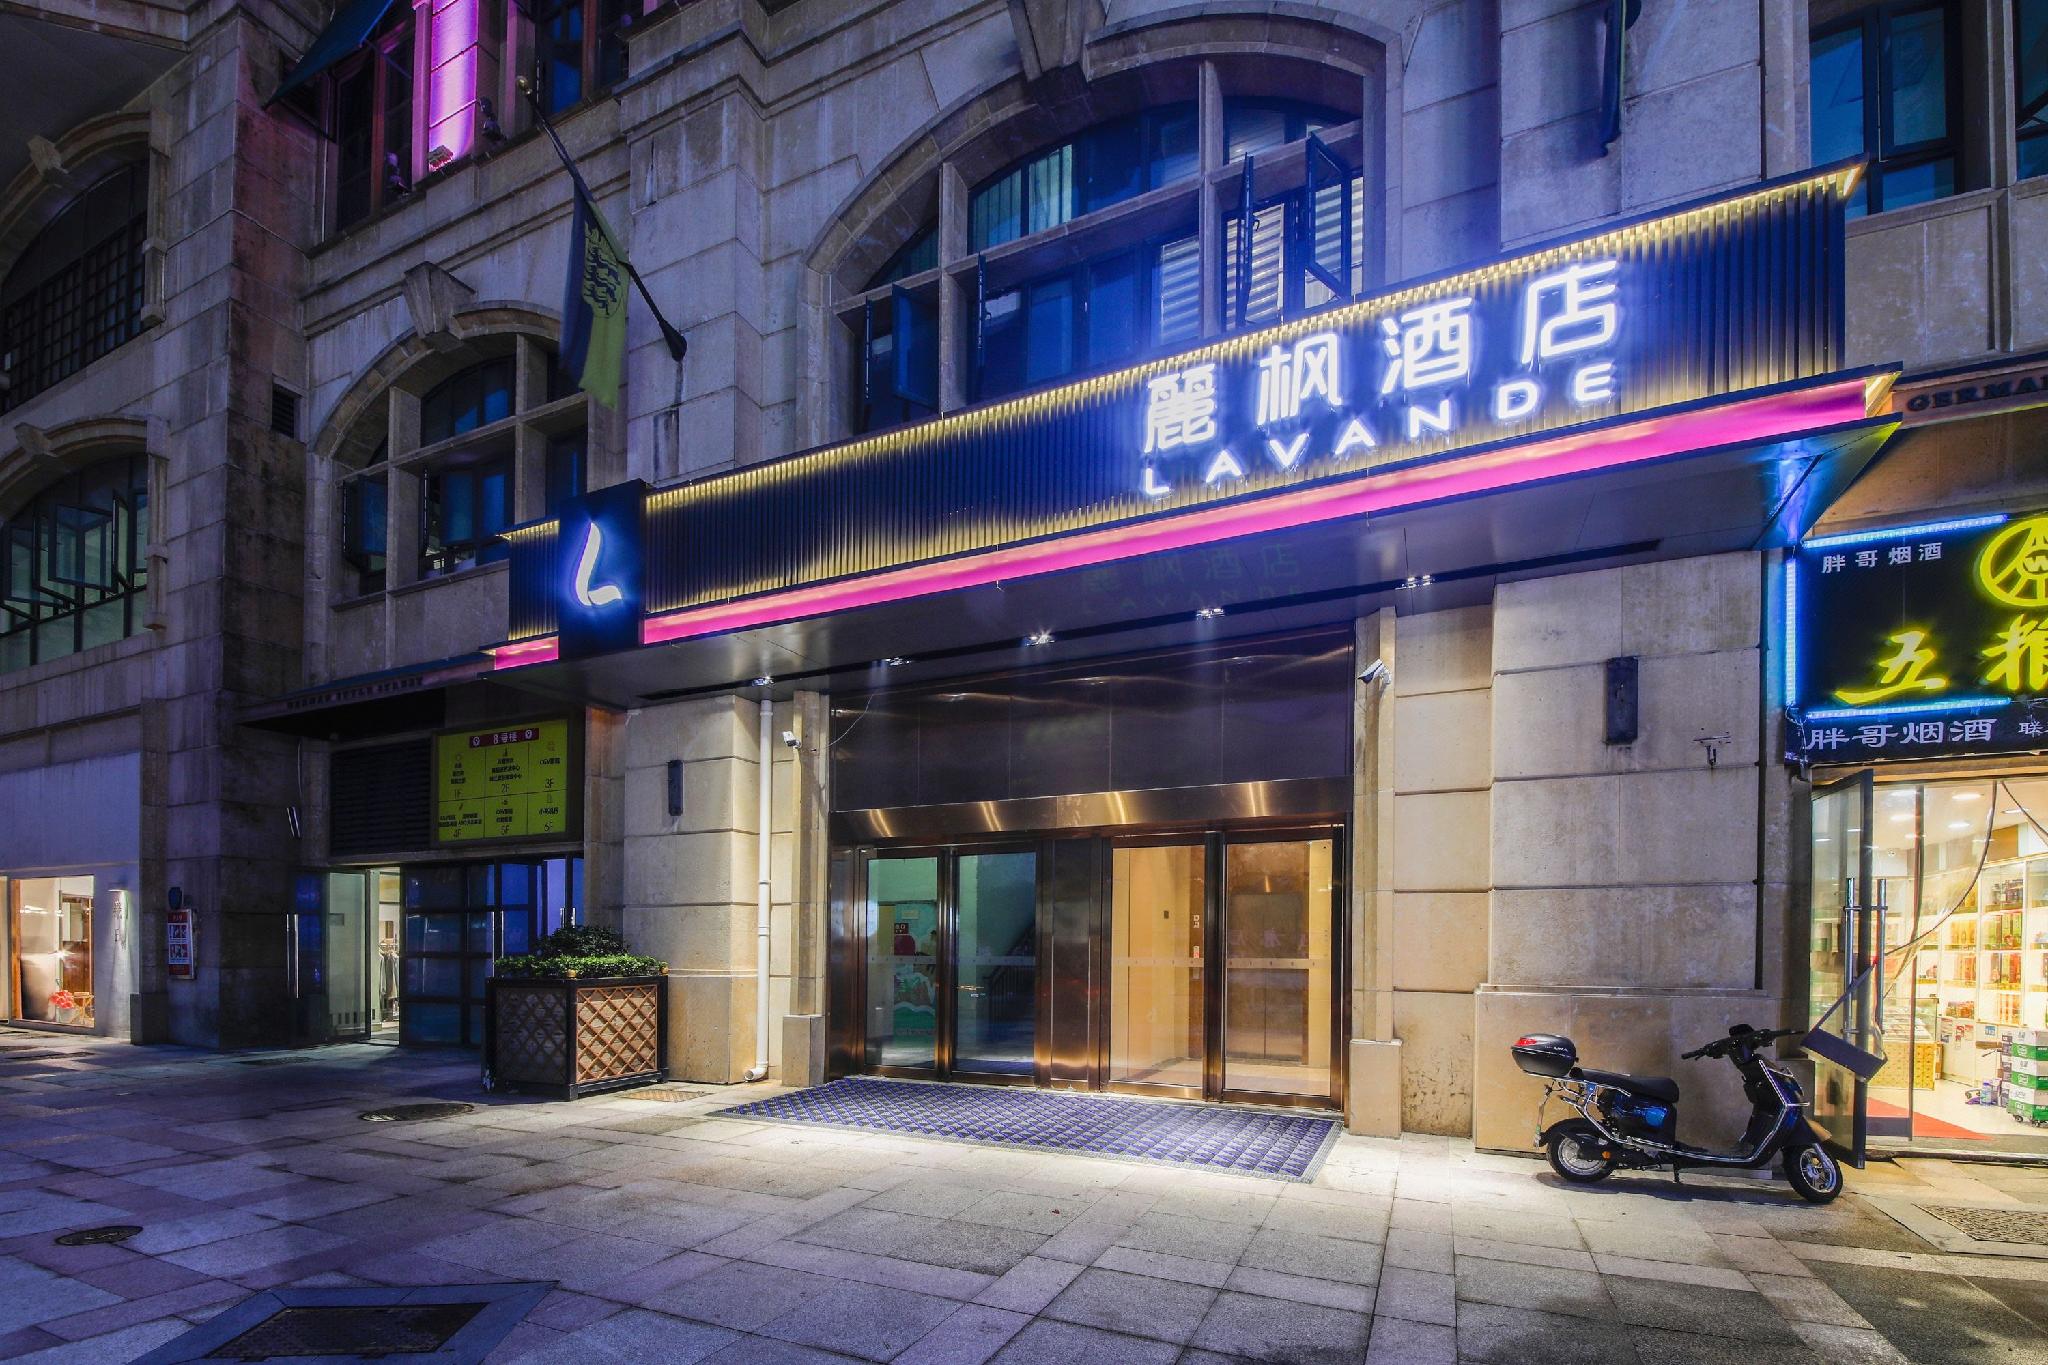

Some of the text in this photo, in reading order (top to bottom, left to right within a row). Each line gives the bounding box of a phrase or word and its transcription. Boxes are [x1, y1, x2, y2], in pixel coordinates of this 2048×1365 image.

[1906, 374, 2048, 412] GERMA
[1141, 362, 1614, 495] LAVANDE
[1821, 541, 1943, 574] 胖哥烟酒
[1805, 718, 1998, 750] 胖哥烟酒
